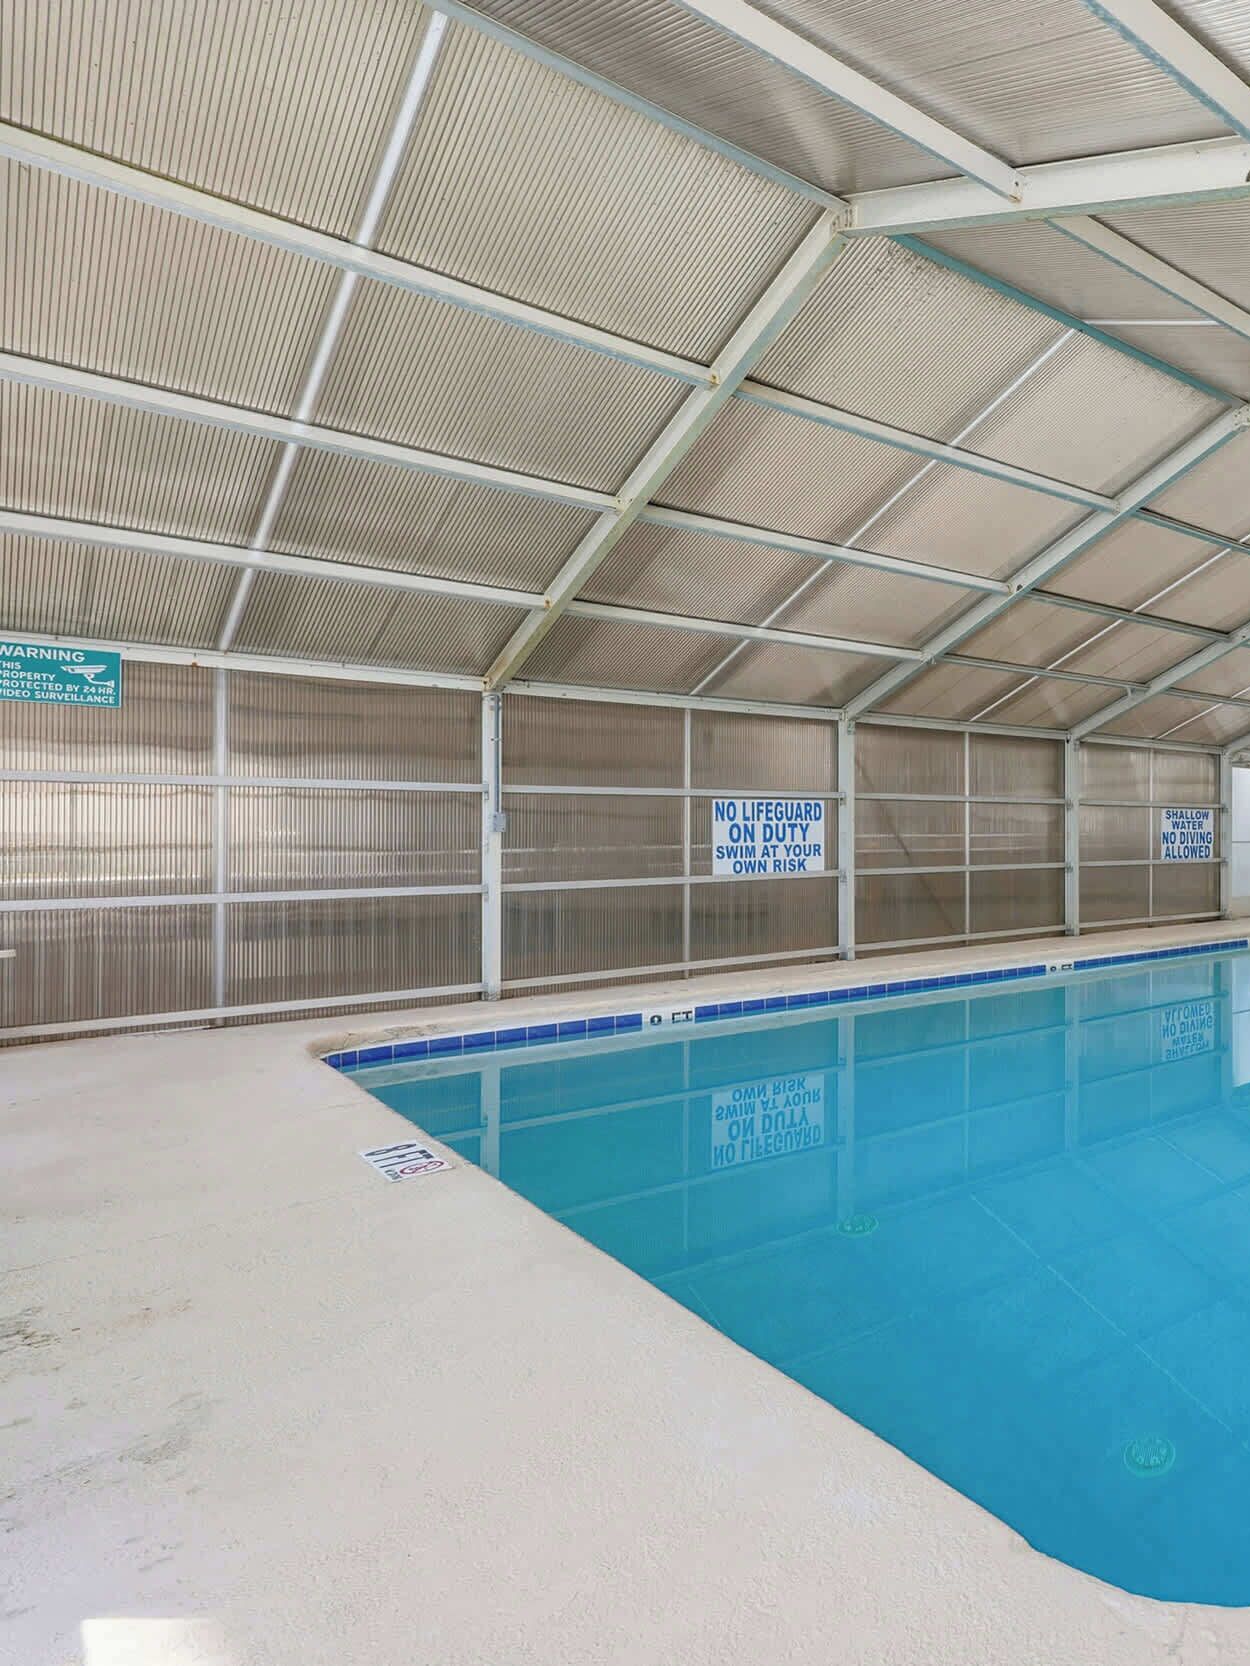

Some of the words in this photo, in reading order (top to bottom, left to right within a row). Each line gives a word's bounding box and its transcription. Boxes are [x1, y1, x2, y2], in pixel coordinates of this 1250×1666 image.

[0, 644, 86, 663] WARNING
[0, 660, 21, 670] HIS
[34, 690, 115, 704] SURVEILLANCE
[66, 684, 80, 692] BY
[83, 685, 95, 693] 24
[98, 687, 116, 696] HR.
[715, 801, 737, 822] NO
[742, 801, 822, 822] LIFEGUARD
[1165, 810, 1209, 820] SHALLOW
[1171, 820, 1203, 830] WATER
[729, 823, 755, 843] ON
[763, 823, 810, 842] DUTY
[1162, 831, 1176, 845] NO
[1180, 831, 1212, 844] DIVING
[716, 845, 756, 859] SWIM
[761, 845, 778, 858] AT
[784, 844, 821, 857] YOUR
[1165, 845, 1210, 859] ALLOWED
[733, 860, 767, 874] OWN
[773, 858, 807, 872] RISK
